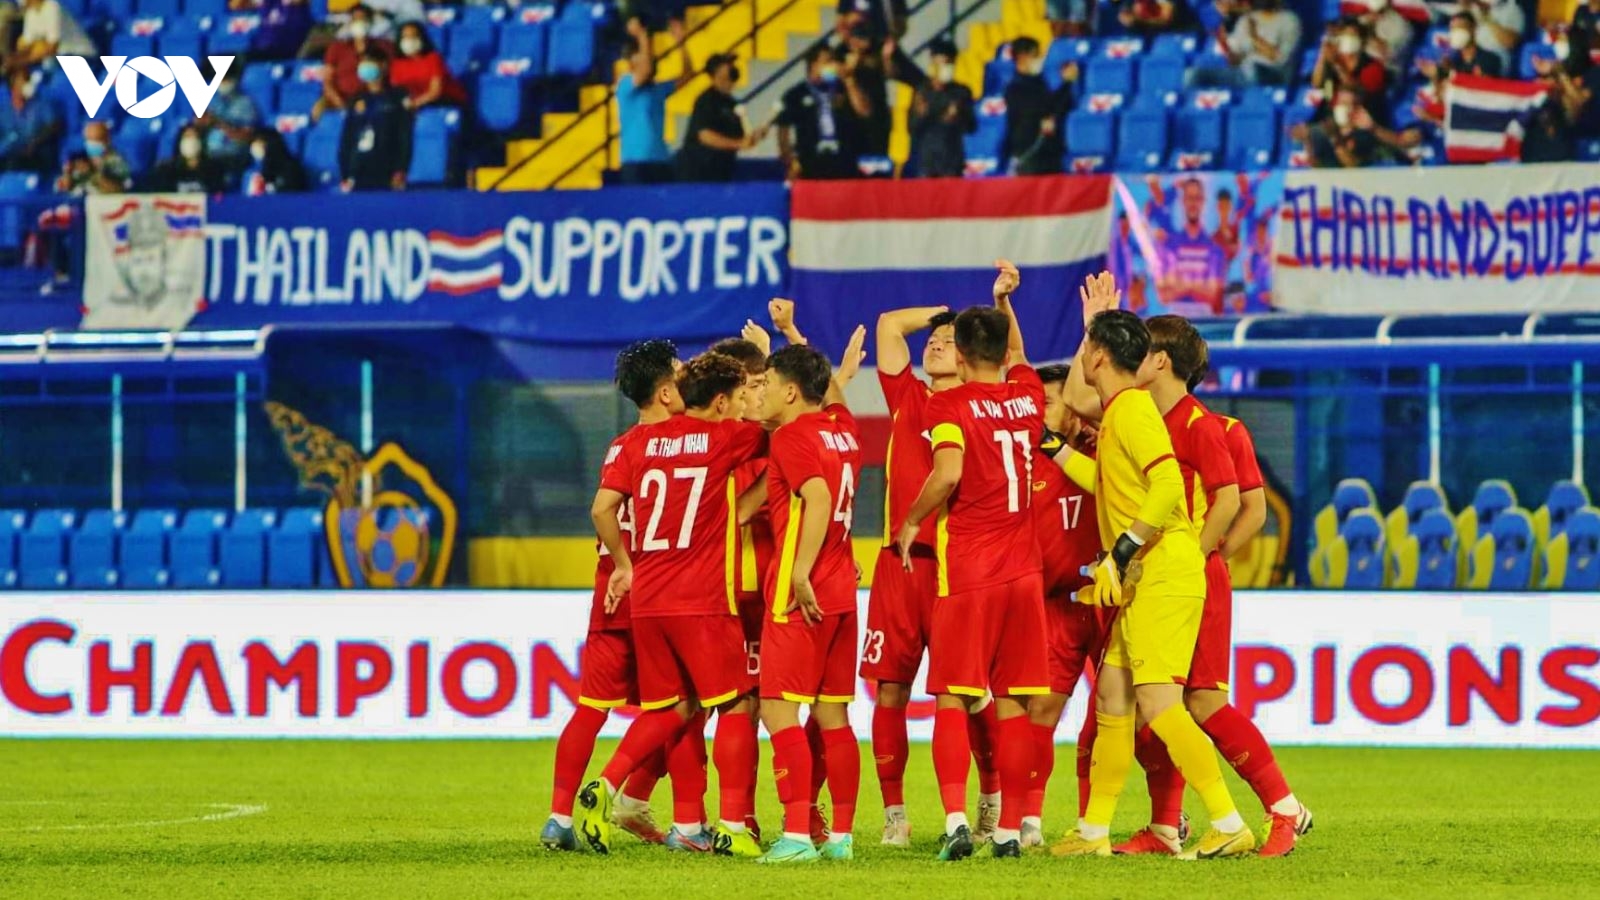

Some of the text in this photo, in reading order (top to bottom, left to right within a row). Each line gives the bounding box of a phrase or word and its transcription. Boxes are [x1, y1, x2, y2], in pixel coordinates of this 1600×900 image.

[202, 215, 786, 305] THAILAND SUPPORTER
[640, 466, 708, 552] 27
[1058, 495, 1083, 530] 17
[0, 618, 1600, 726] CHAMPION PIONS
[744, 640, 761, 675] 5
